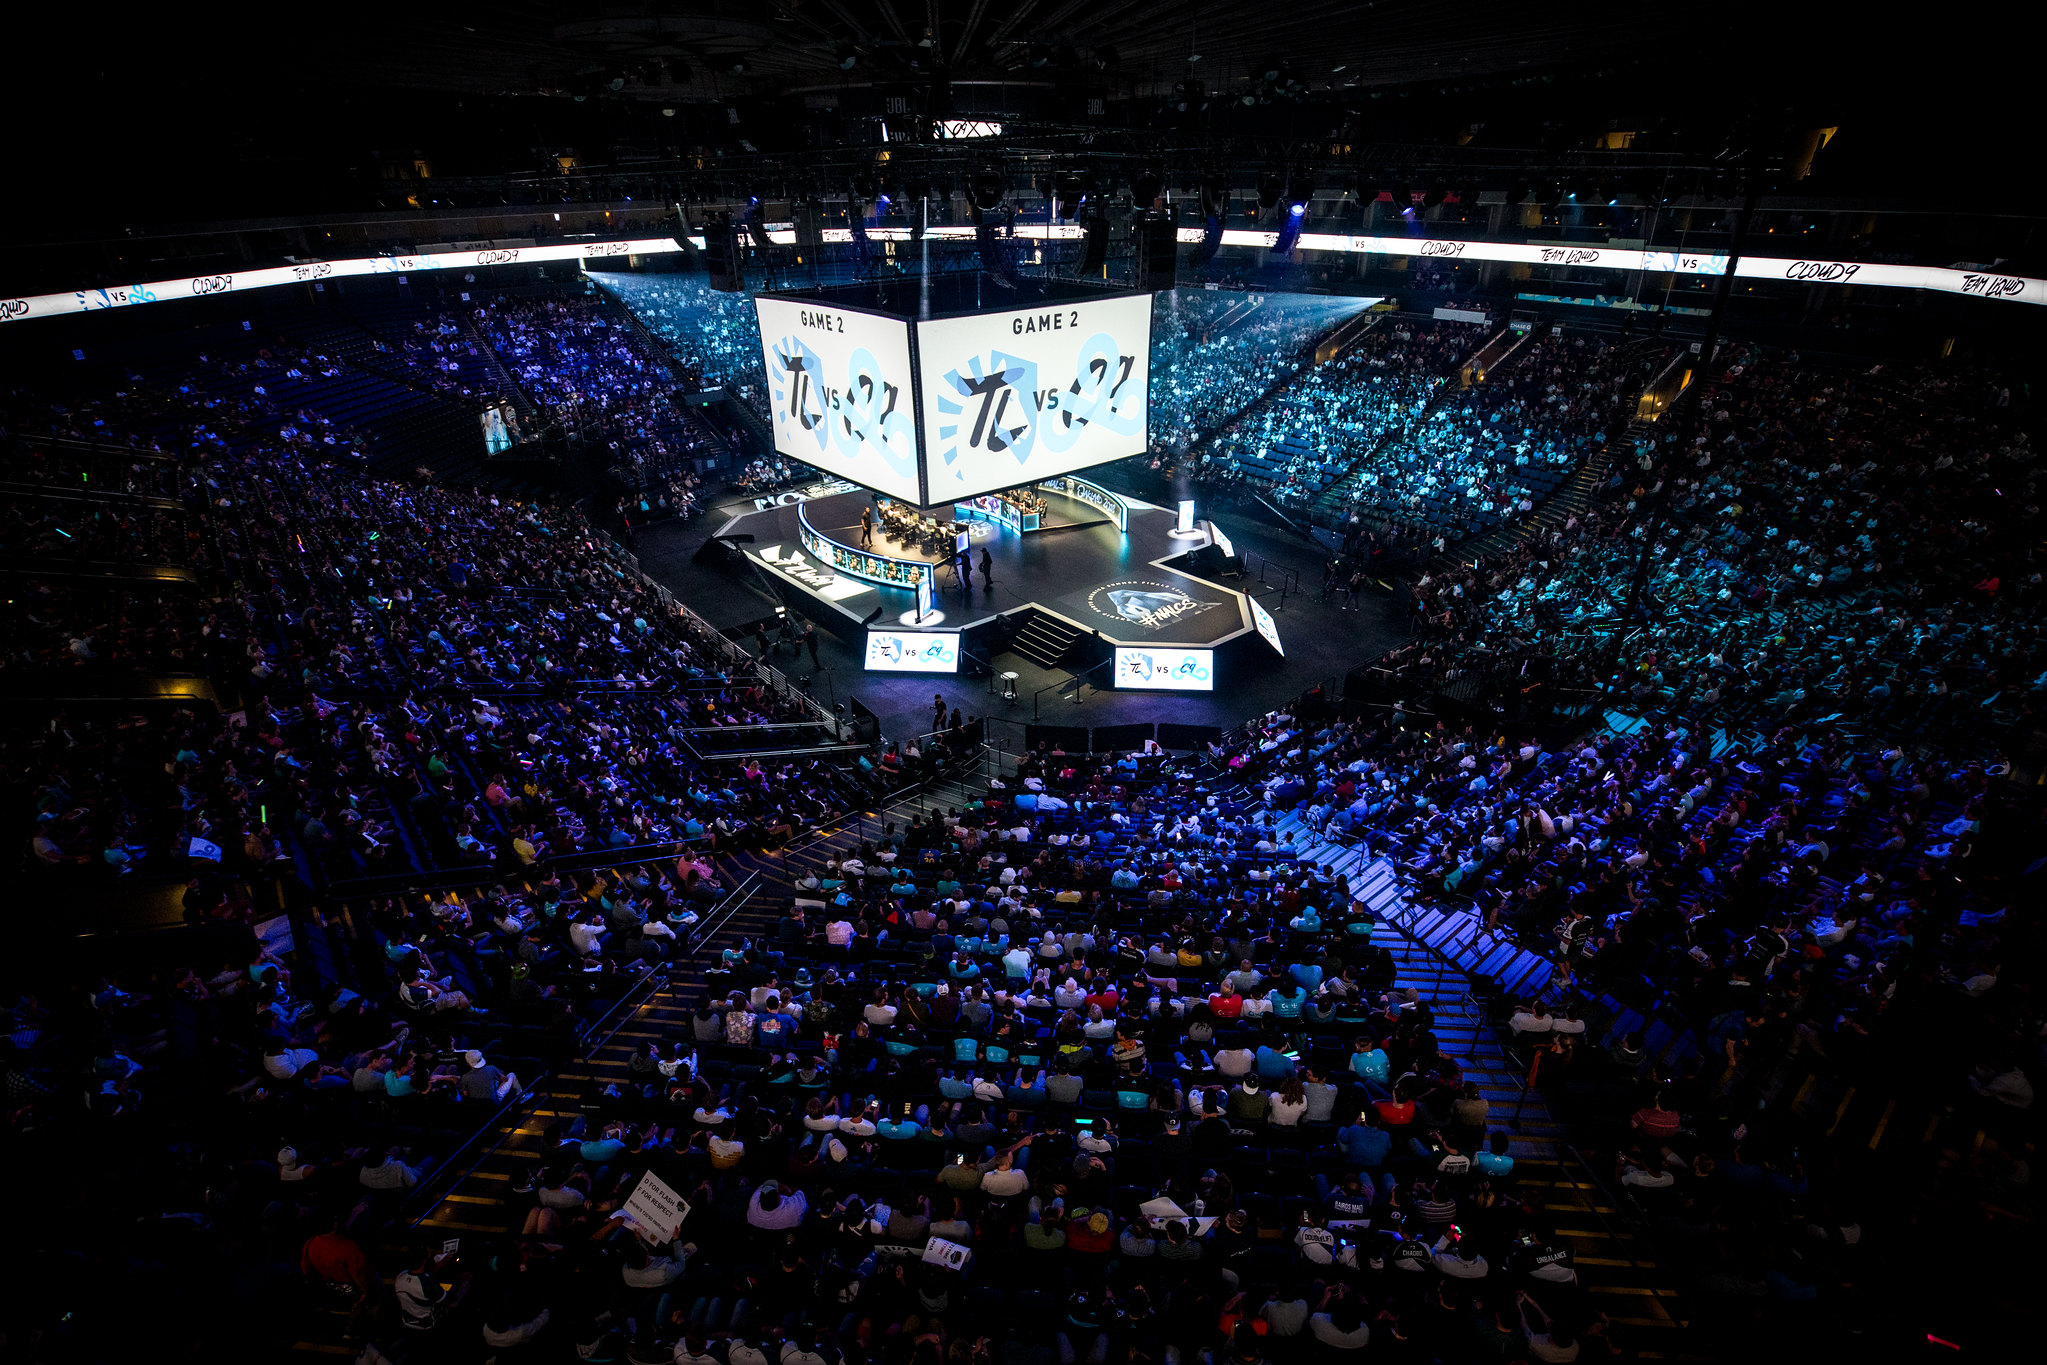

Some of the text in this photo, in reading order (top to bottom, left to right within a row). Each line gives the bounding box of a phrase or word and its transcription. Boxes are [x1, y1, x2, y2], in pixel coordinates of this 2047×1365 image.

[1088, 98, 1104, 114] JBL
[477, 250, 518, 265] CLOUD9
[1420, 241, 1465, 257] CLOUD9
[1541, 249, 1564, 262] TEAM
[1682, 258, 1697, 268] VS
[292, 267, 310, 279] TEAM
[1786, 261, 1860, 283] CLOUD9
[192, 275, 232, 295] CLOUD9
[1961, 274, 1989, 292] TEAM
[112, 291, 126, 302] VS
[801, 310, 844, 333] GAME 2
[1012, 311, 1078, 335] GAME 2
[822, 386, 840, 410] VS
[1033, 388, 1059, 412] VS
[1138, 598, 1197, 626] #NALCS
[881, 646, 891, 656] TL
[927, 646, 942, 656] C9
[1130, 663, 1141, 673] TL
[1180, 663, 1196, 673] C9
[649, 1182, 659, 1193] FOR
[659, 1190, 675, 1206] FLASH
[641, 1190, 652, 1201] FOR
[651, 1198, 673, 1217] RESPECT
[1536, 1251, 1567, 1264] UNBALANCE
